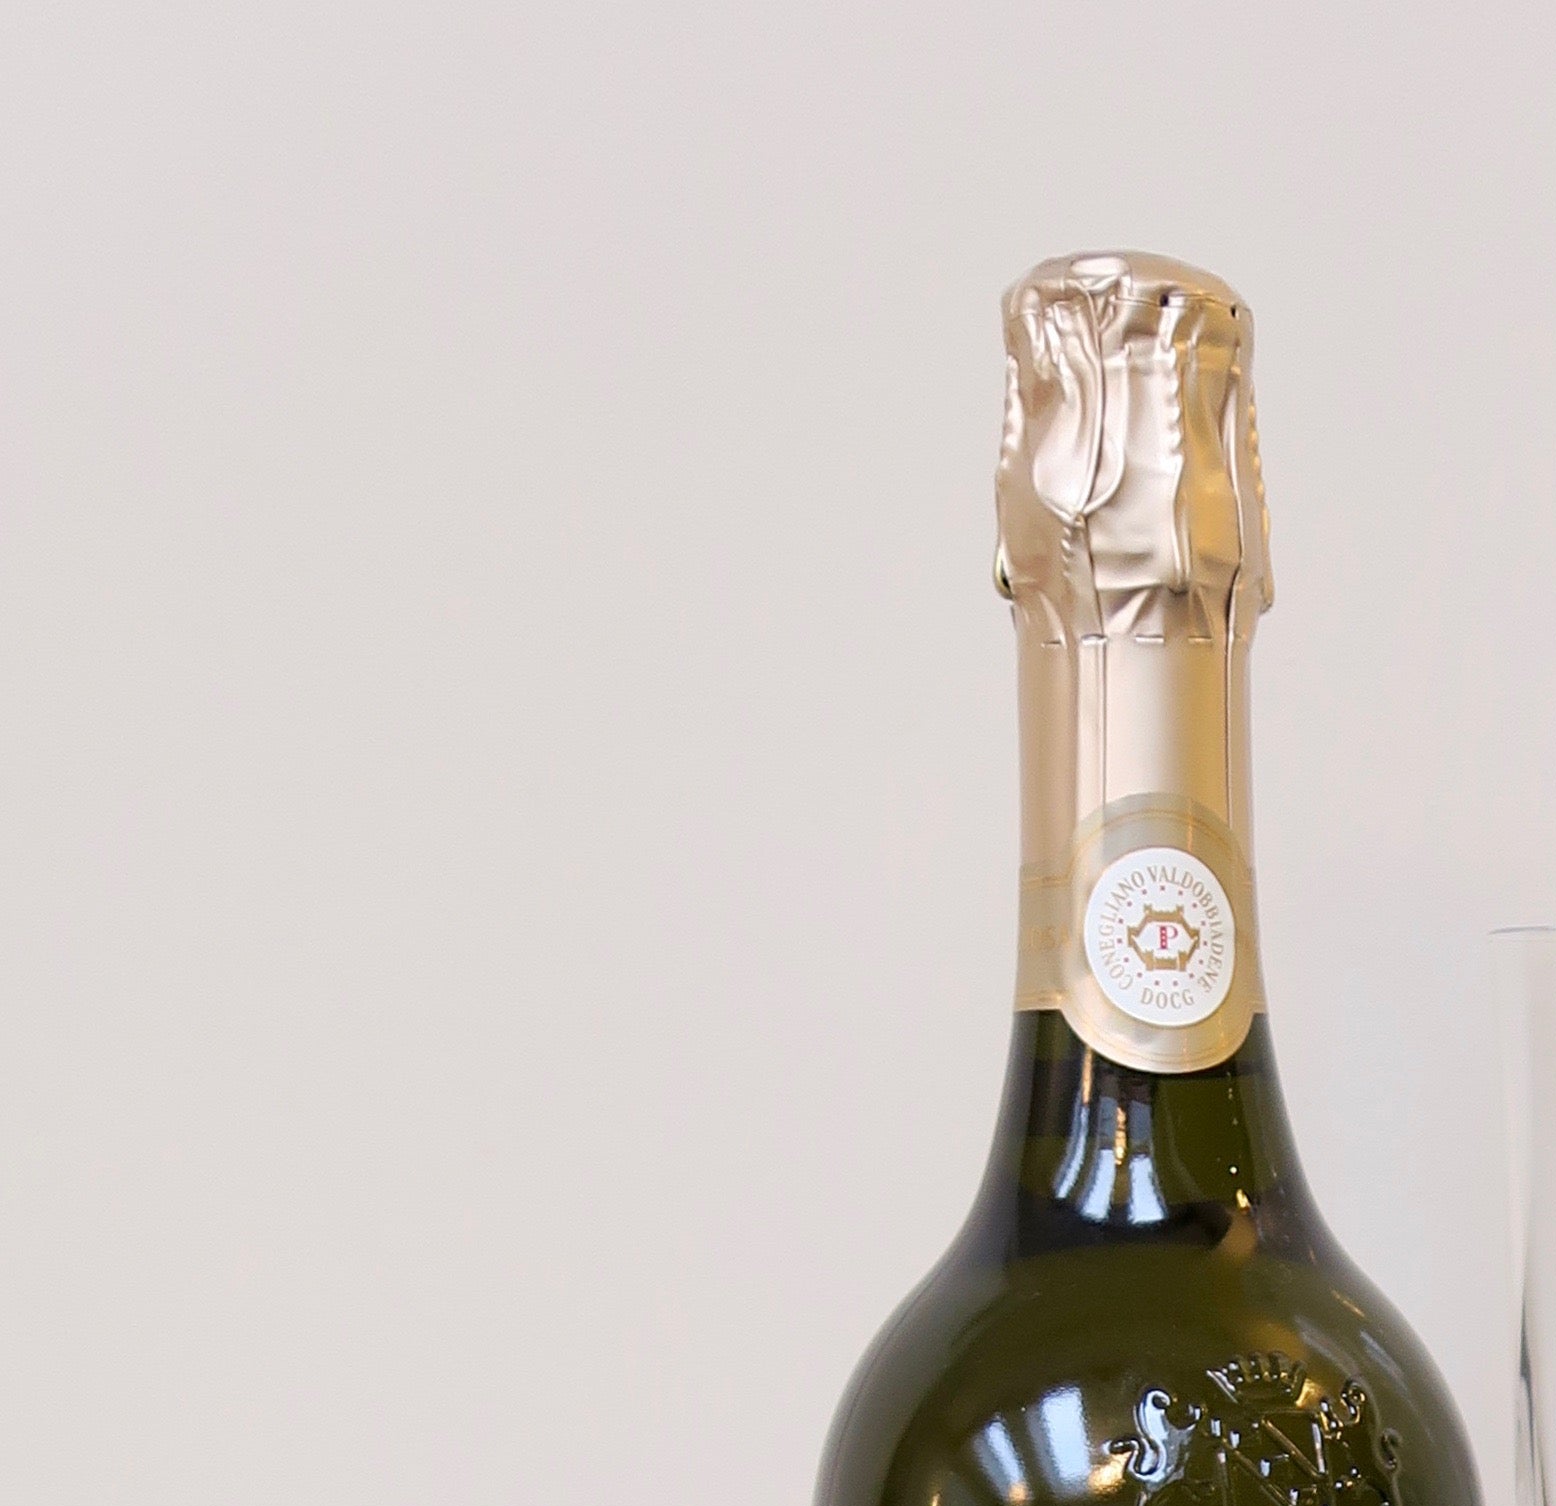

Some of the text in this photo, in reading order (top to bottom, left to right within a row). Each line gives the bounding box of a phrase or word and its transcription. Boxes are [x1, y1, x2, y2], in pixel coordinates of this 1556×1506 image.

[1099, 865, 1224, 994] CONEGLIANO VALDOBBIADENE
[1157, 925, 1179, 950] P
[1140, 988, 1195, 1010] DOCG
